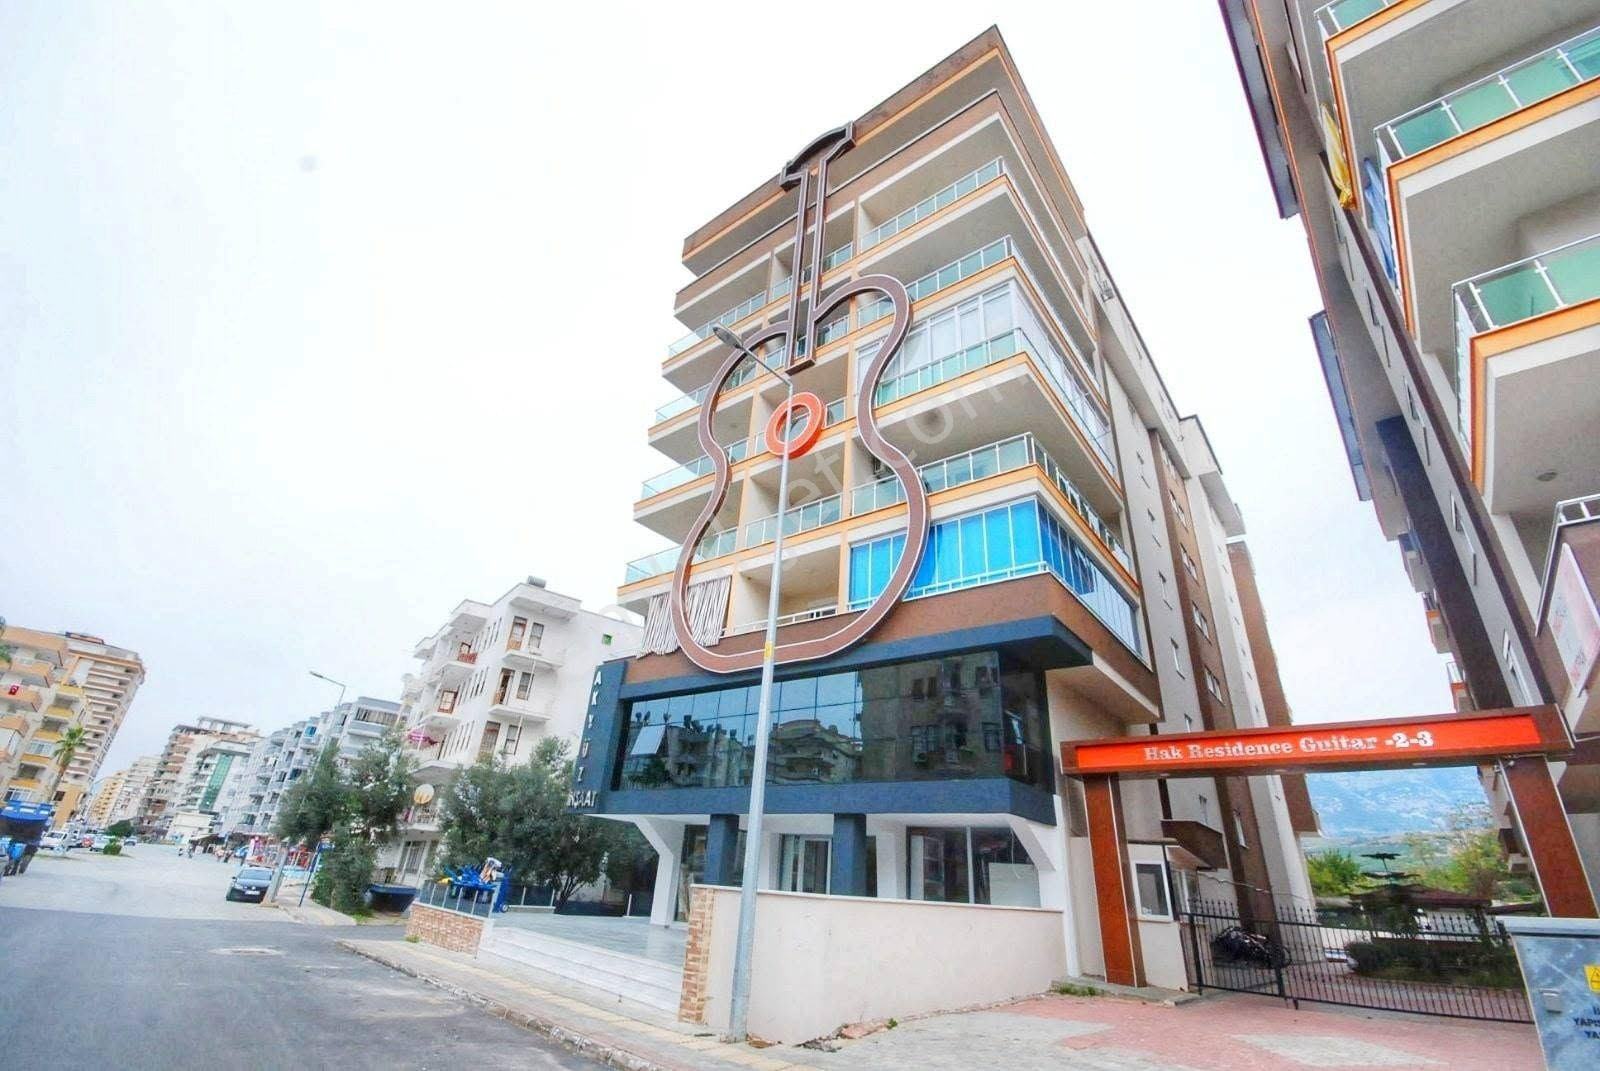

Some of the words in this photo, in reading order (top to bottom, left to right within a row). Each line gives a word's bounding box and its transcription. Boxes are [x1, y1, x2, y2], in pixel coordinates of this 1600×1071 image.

[1143, 745, 1184, 761] Hak
[1187, 742, 1294, 759] Residence
[1299, 734, 1378, 752] Guitar
[1384, 730, 1434, 748] -2-3
